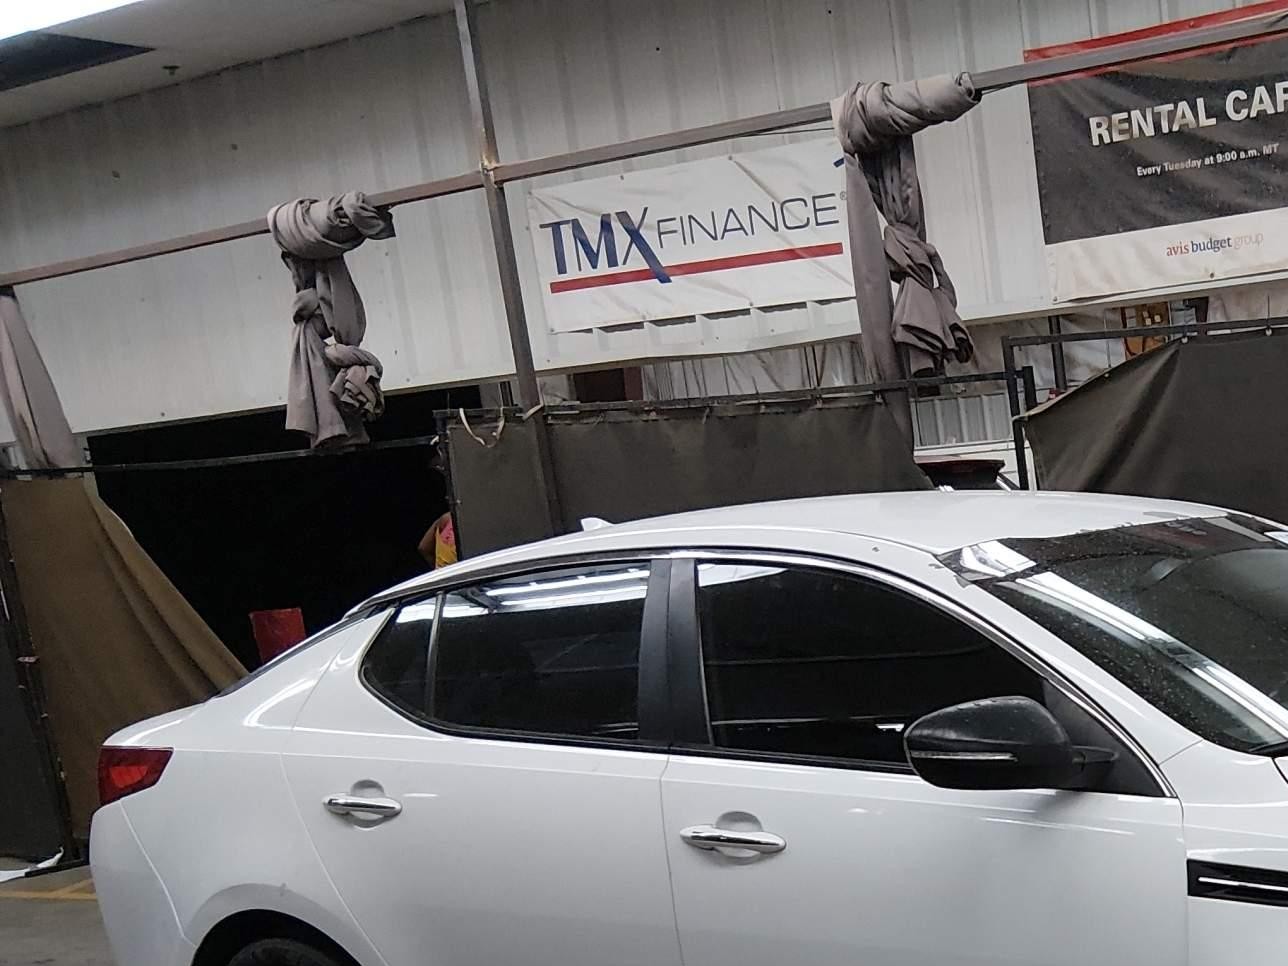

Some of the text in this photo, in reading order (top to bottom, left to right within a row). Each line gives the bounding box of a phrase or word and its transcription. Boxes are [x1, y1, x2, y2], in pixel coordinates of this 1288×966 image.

[1089, 97, 1217, 146] RENTAL
[1136, 143, 1279, 177] Every Tuesday at 9:00 a.m. MT
[539, 193, 840, 283] TMX FINANCE
[1166, 232, 1264, 257] avis budget group
